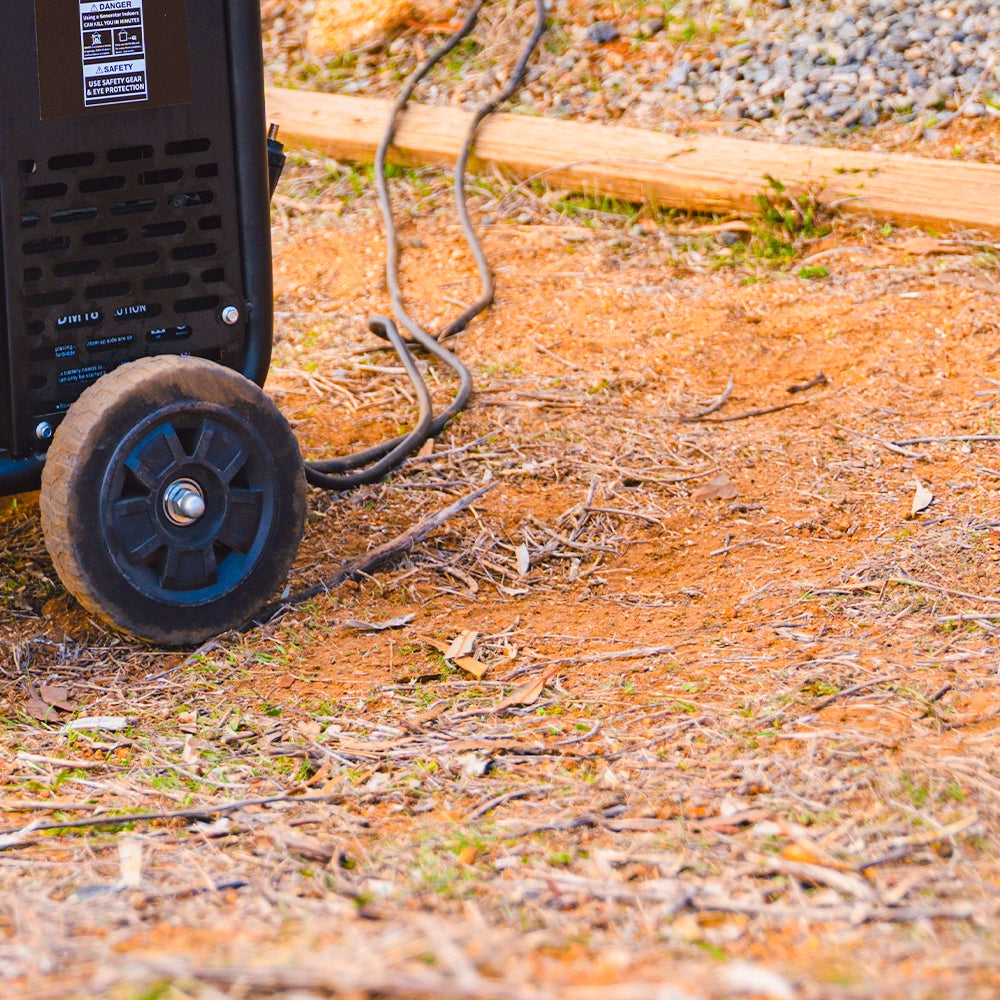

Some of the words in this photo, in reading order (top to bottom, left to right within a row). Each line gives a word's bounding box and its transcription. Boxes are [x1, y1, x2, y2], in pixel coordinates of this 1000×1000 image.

[99, 1, 132, 10] DANGER
[104, 63, 133, 73] SAFETY
[88, 79, 101, 87] USE
[101, 77, 125, 86] SAFETY
[125, 75, 142, 84] GEAR
[92, 87, 104, 95] EYE
[105, 83, 145, 94] PROTECTION
